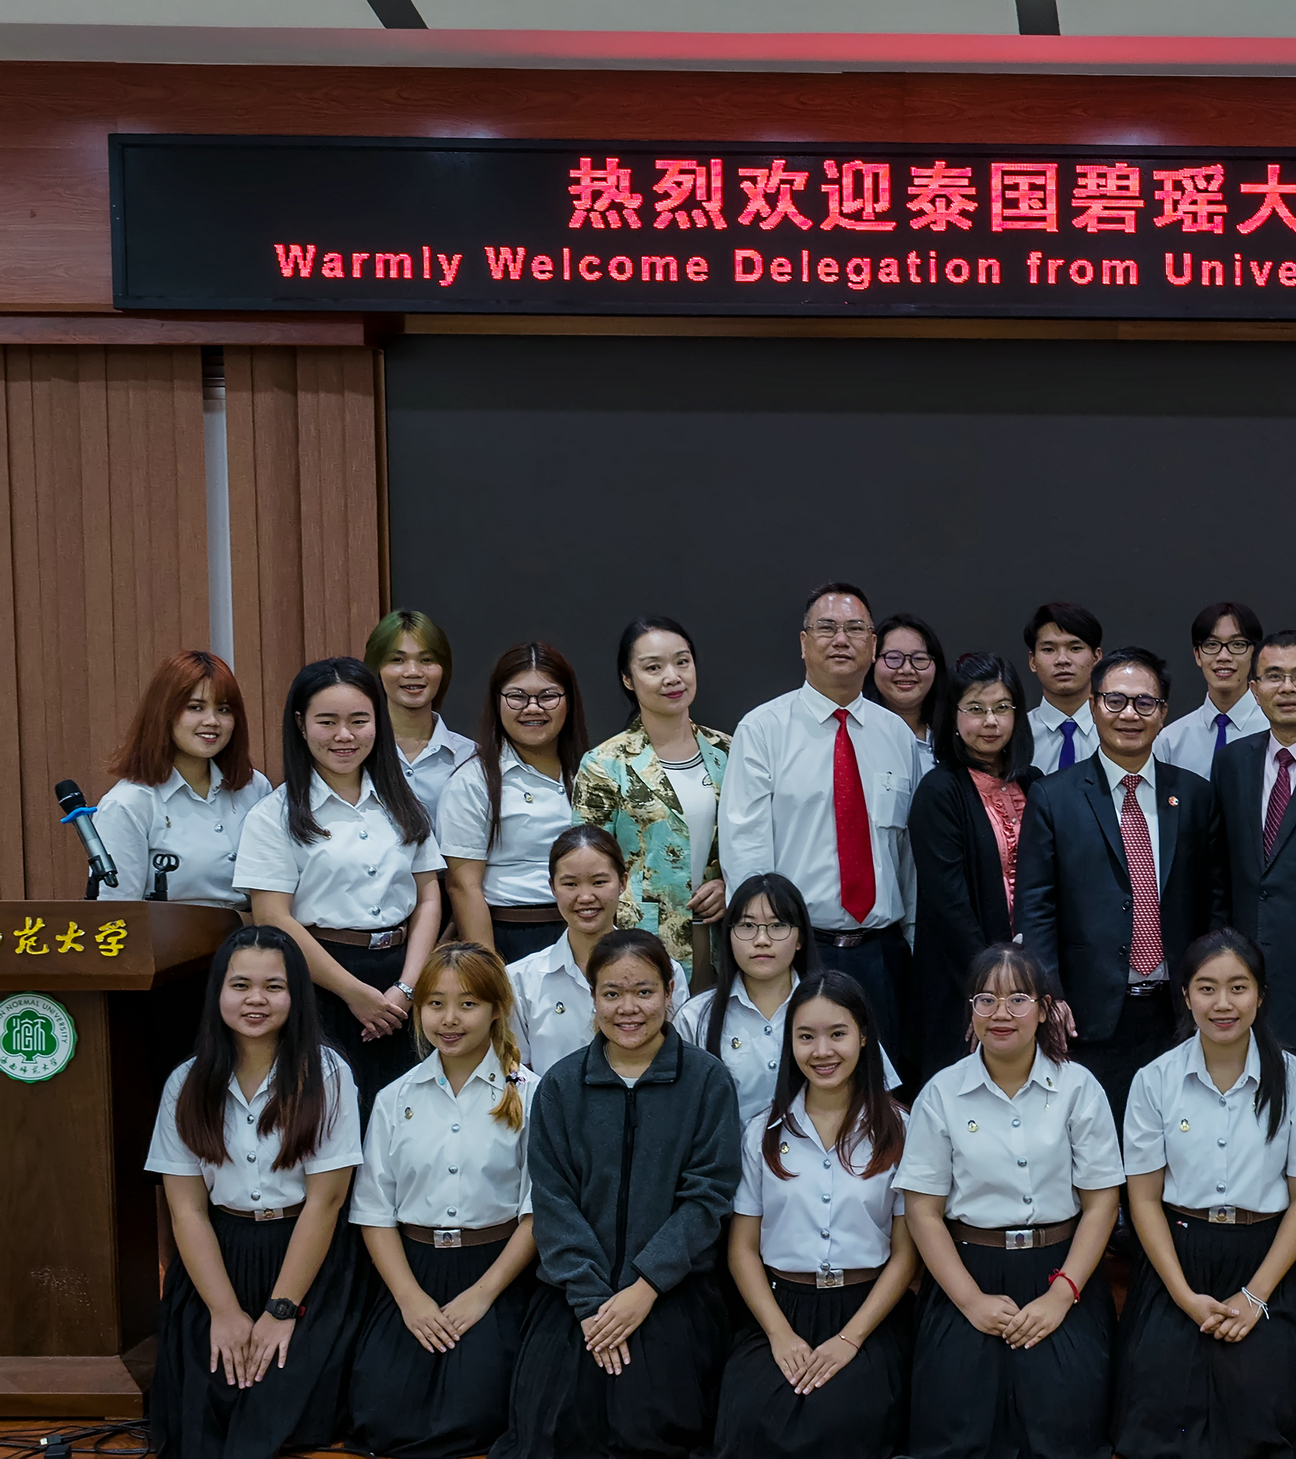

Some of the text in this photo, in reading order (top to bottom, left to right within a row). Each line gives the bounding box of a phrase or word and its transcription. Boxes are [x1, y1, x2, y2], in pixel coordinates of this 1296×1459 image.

[273, 243, 463, 287] Warmly
[484, 246, 709, 283] Welcome
[734, 249, 1002, 291] Delegation
[1026, 251, 1139, 286] from
[0, 916, 128, 957] 范大学
[6, 999, 39, 1011] NORMAL
[42, 1003, 68, 1044] UNIVERSITY
